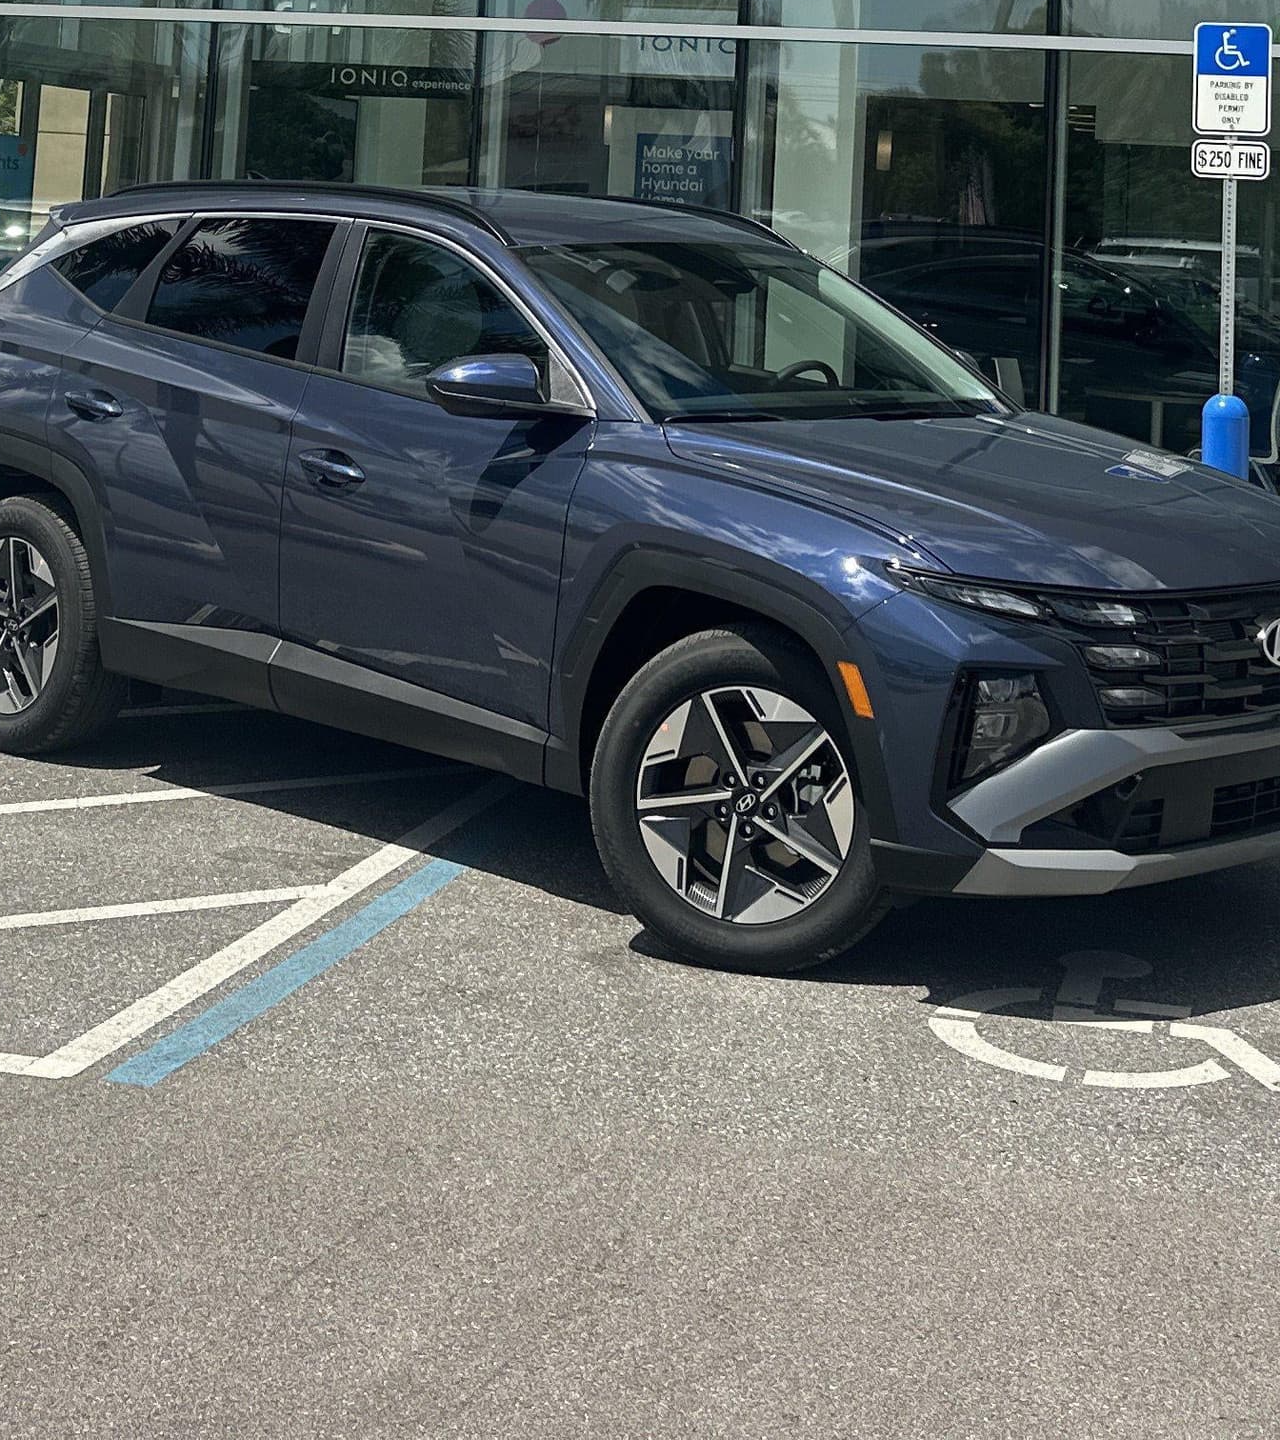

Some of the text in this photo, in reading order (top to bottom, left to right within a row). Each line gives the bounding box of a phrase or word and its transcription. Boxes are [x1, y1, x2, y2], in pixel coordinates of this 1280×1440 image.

[330, 67, 471, 91] IONIQ experience
[1210, 81, 1254, 90] PARKING BY
[1214, 93, 1249, 101] DISABLED
[643, 145, 720, 161] Make your
[1198, 150, 1263, 169] $250 FINE
[642, 160, 697, 175] home a
[641, 177, 704, 192] Hyundai
